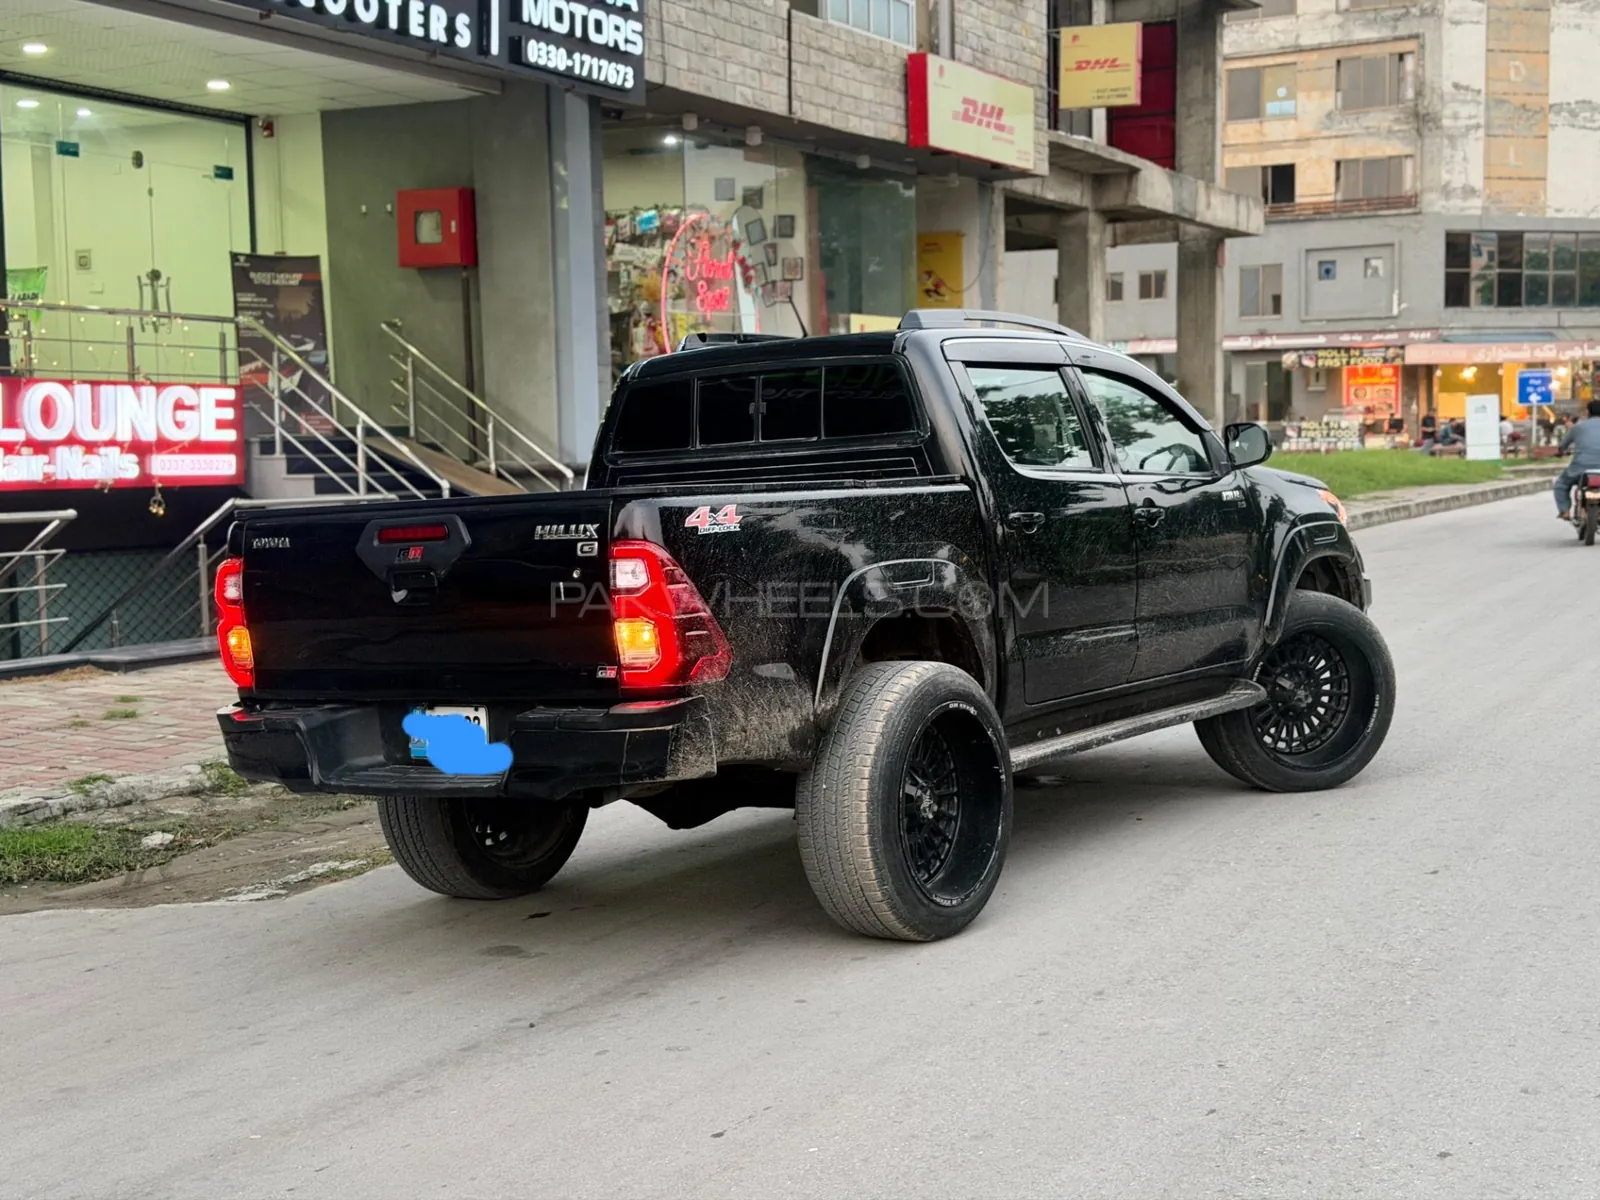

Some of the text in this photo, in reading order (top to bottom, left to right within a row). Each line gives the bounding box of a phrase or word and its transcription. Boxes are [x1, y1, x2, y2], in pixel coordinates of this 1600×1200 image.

[522, 0, 643, 55] MOTORS
[527, 39, 634, 88] 0330-1717673
[1074, 57, 1119, 71] DHL
[961, 96, 1005, 132] DHL
[1318, 350, 1347, 358] ROLL
[1318, 357, 1384, 367] FAST FOOD
[0, 381, 237, 442] LOUNGE
[0, 445, 140, 481] air-Nails
[534, 523, 600, 540] HILUX
[578, 541, 597, 556] G
[597, 666, 618, 678] GR
